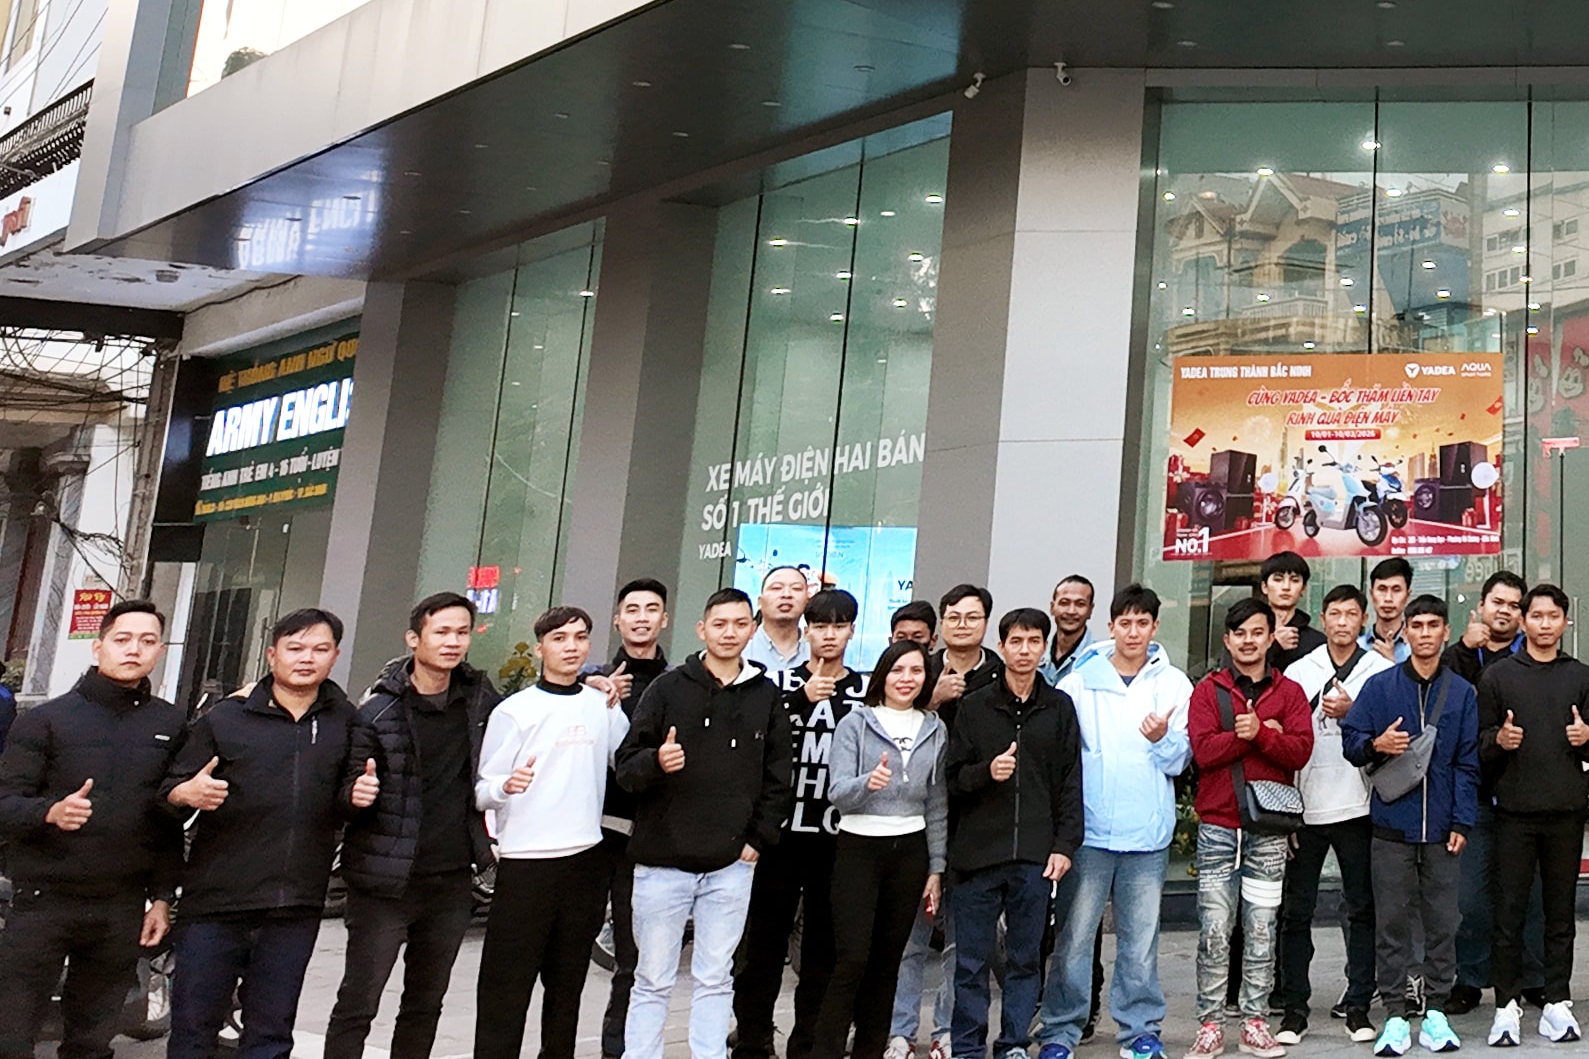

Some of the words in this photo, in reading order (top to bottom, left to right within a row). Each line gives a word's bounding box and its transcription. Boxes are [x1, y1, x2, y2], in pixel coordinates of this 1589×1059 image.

[1180, 366, 1208, 379] YADEA
[1209, 366, 1238, 379] TRUNG
[1240, 363, 1269, 378] THÀNH
[1421, 365, 1456, 376] YADEA
[1247, 385, 1280, 405] CÙNG
[1281, 390, 1317, 405] YADEA
[1328, 378, 1355, 404] BỐC
[1390, 381, 1413, 404] LIỀN
[1416, 388, 1441, 404] TAY
[205, 395, 281, 458] ARMY
[1286, 411, 1317, 426] RINH
[1316, 406, 1342, 426] QUÀ
[1343, 407, 1370, 428] ĐIỆN
[1371, 406, 1401, 425] MÁY
[705, 462, 731, 493] XE
[734, 452, 777, 489] MÁY
[780, 444, 829, 485] ĐIỆN
[834, 440, 872, 475] HAI
[701, 493, 729, 531] SỐ
[731, 500, 741, 529] 1
[746, 484, 785, 524] THẾ
[787, 481, 831, 521] GIỚI
[698, 540, 732, 560] YADEA
[1174, 526, 1210, 554] NO.1
